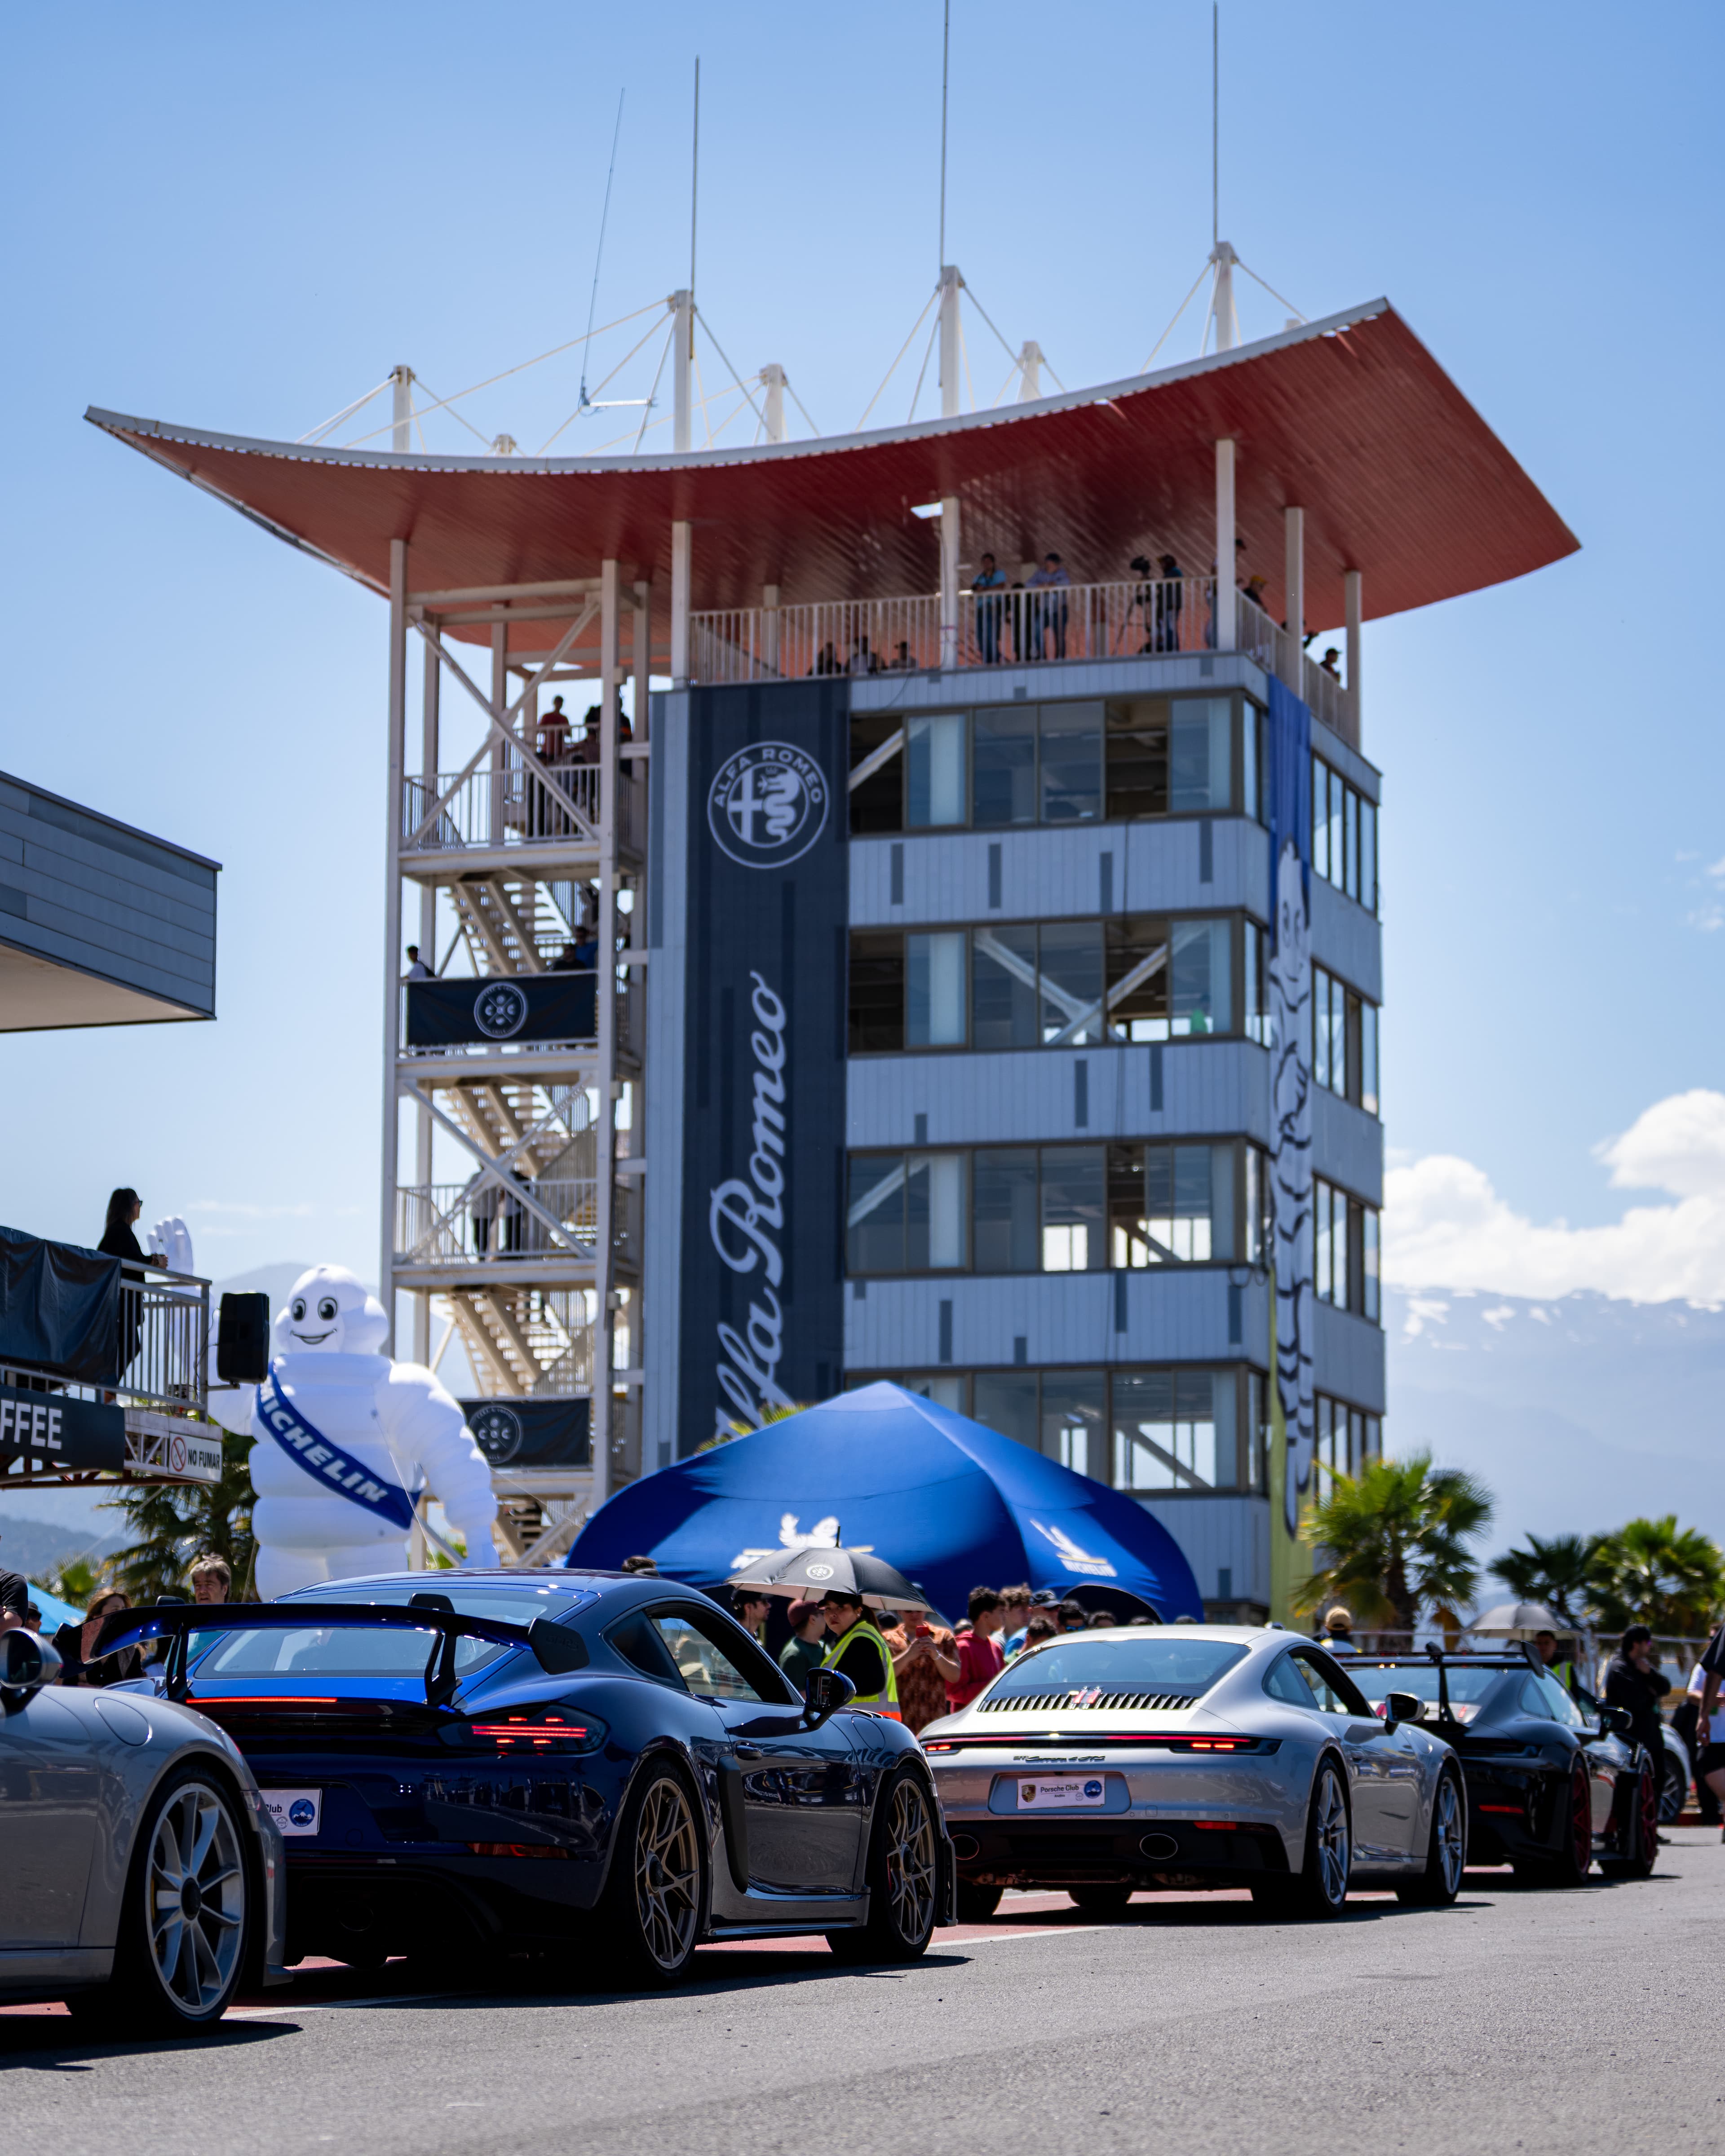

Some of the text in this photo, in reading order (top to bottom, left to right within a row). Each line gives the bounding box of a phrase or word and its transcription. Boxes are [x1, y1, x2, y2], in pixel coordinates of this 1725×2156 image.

[714, 747, 823, 808] ALFA ROMEO
[709, 970, 786, 1288] Romeo
[188, 1449, 220, 1470] NO FUMAR
